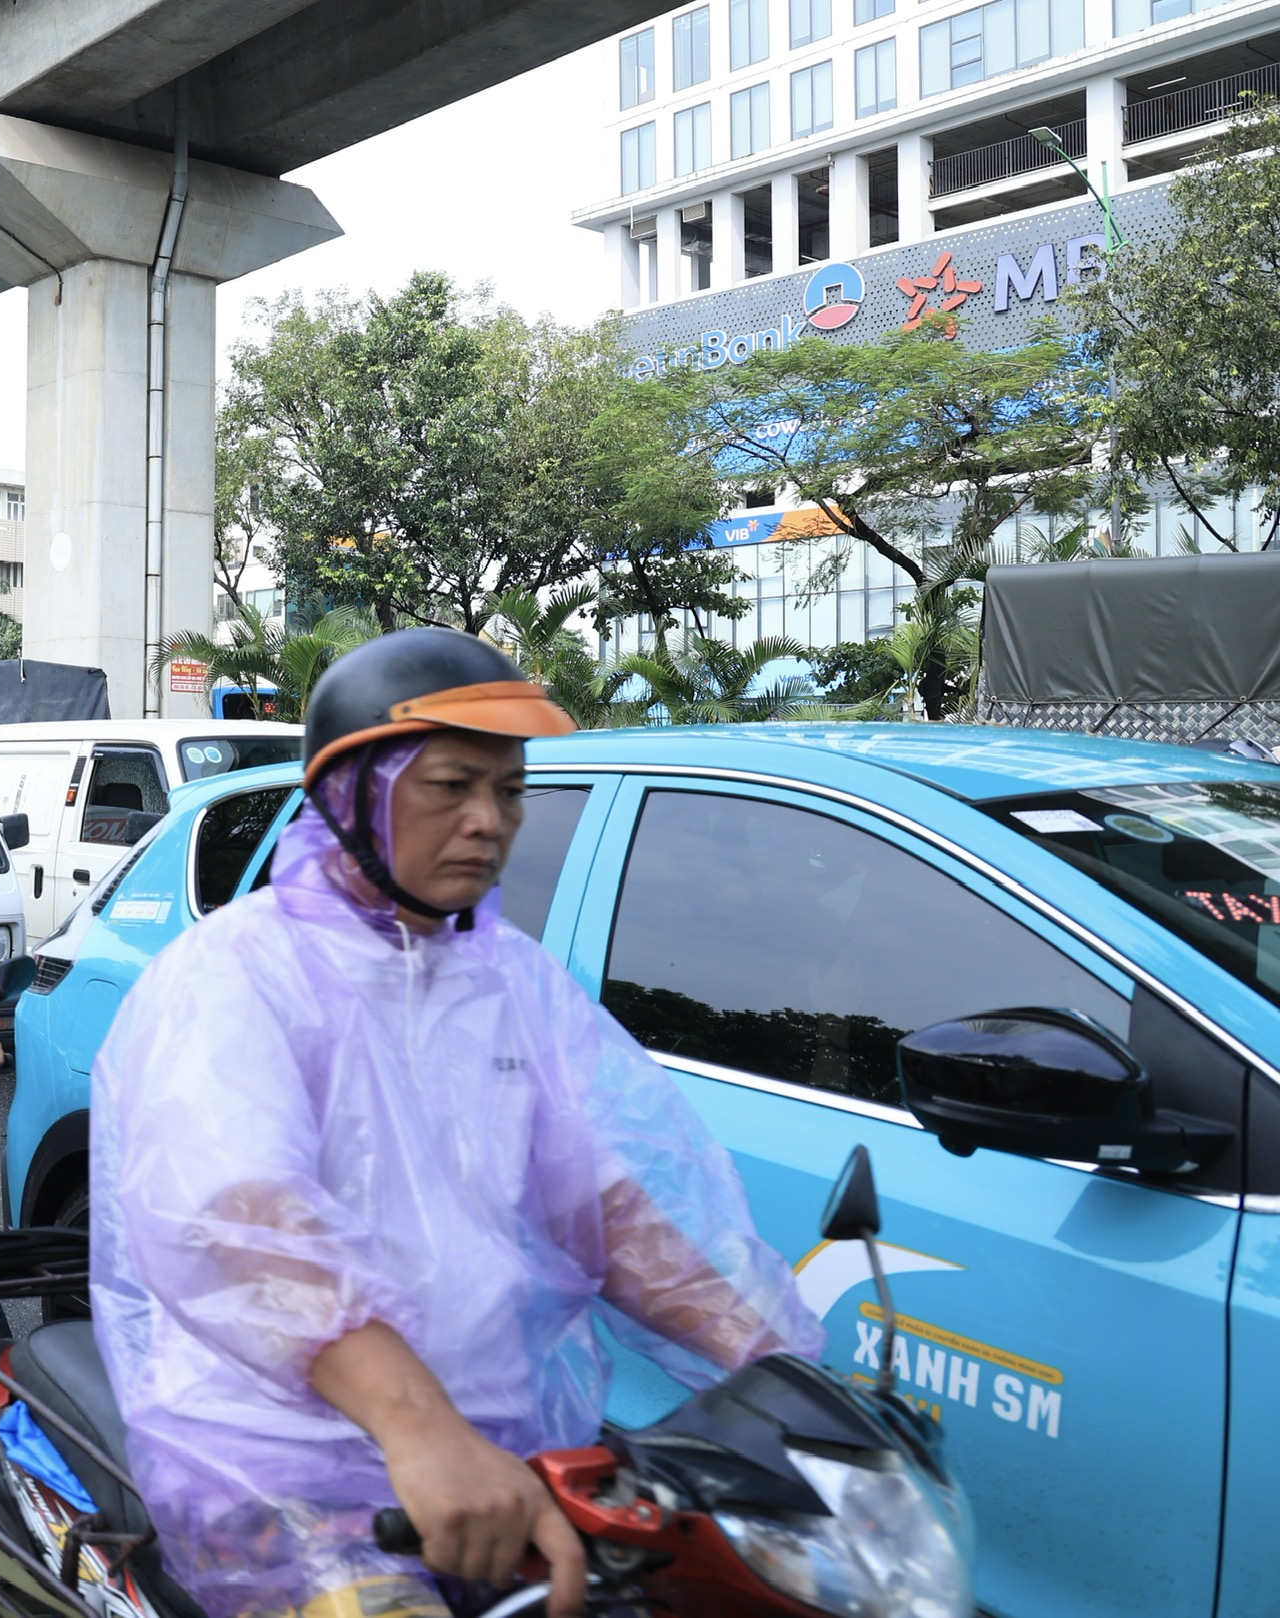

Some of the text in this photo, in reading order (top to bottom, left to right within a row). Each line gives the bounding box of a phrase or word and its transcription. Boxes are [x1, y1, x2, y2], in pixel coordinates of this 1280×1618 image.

[624, 314, 807, 383] etinBank
[725, 527, 750, 542] VIB
[854, 1320, 980, 1408] XANH
[992, 1373, 1062, 1439] SM
